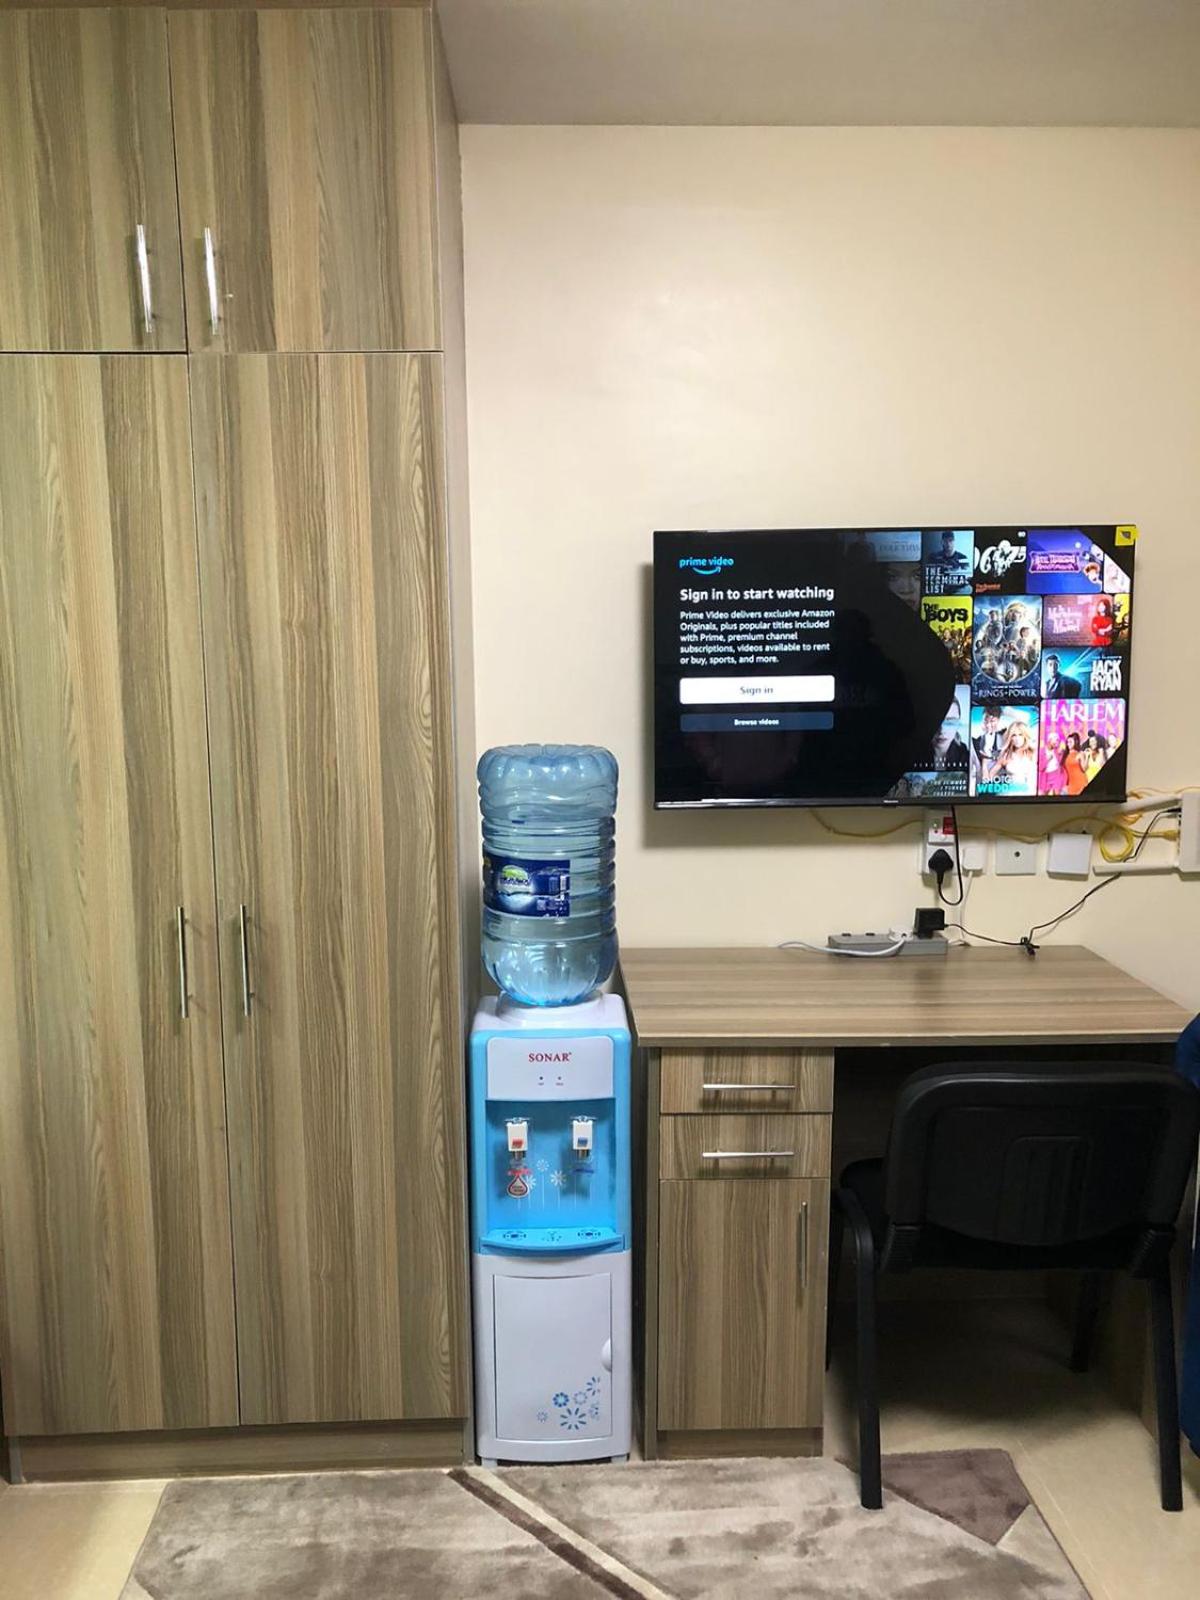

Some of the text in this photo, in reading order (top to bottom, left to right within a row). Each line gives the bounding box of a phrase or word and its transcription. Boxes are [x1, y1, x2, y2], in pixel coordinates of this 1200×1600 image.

[679, 556, 734, 568] prime video
[925, 567, 942, 576] THE
[680, 586, 835, 603] Sign in to start watching
[925, 584, 944, 594] LIST
[680, 609, 835, 619] Prime Video delivers exclusive Amazon
[922, 603, 939, 613] THE
[927, 608, 968, 623] BOYS
[680, 620, 830, 632] Originals, plus popular titles included
[680, 631, 798, 643] with Prime, premium channel
[680, 643, 830, 654] subscriptions, videos available to rent
[680, 654, 779, 666] or buy, sports, and more.
[1092, 660, 1122, 673] JACK
[1090, 672, 1122, 691] RYAN
[740, 684, 774, 696] Sign in
[1008, 689, 1037, 697] POWER
[1041, 702, 1125, 722] HARLEM
[734, 718, 780, 726] Browse videos
[528, 1052, 569, 1063] SONAR
